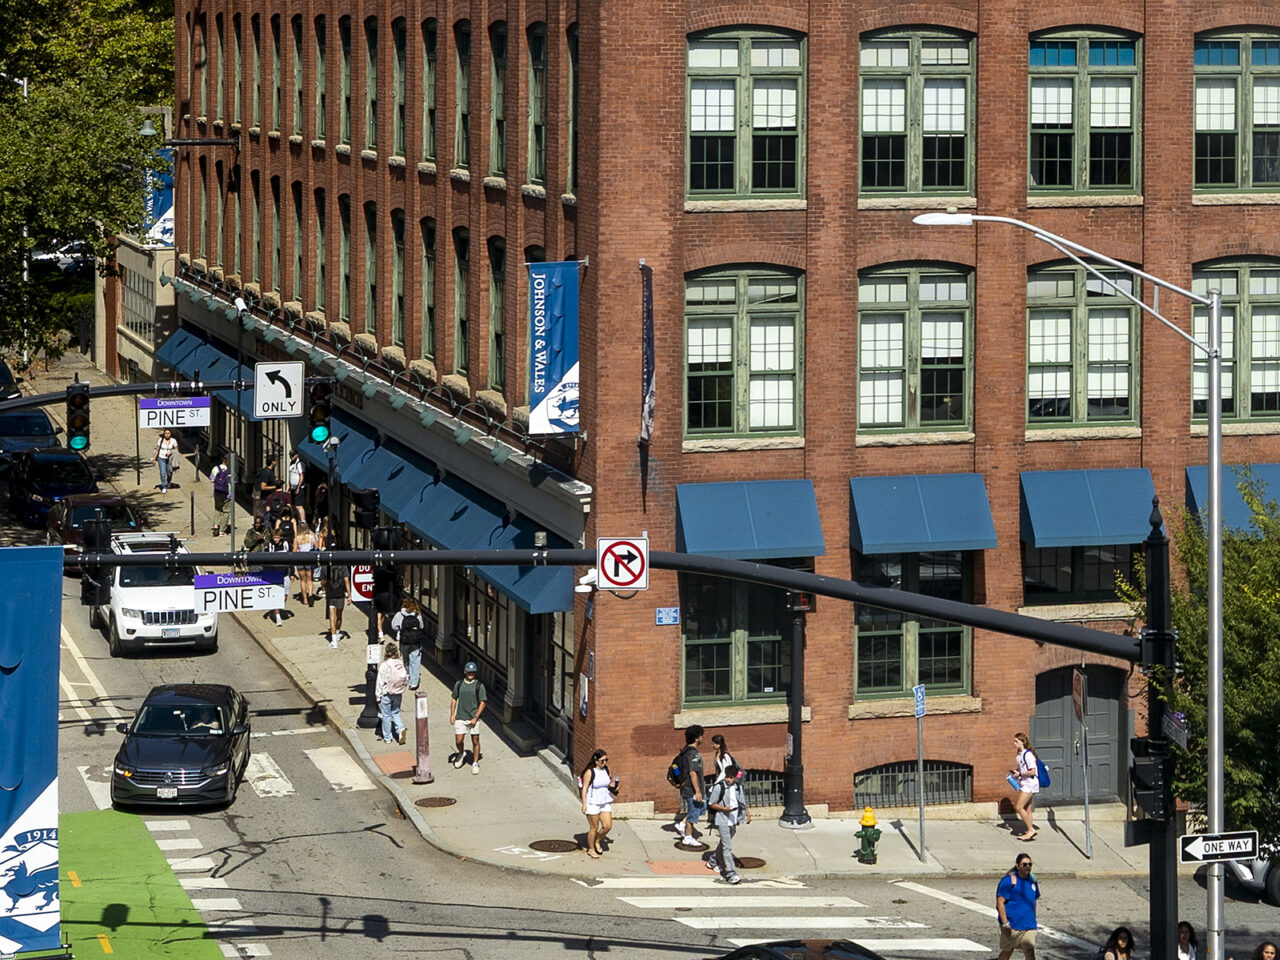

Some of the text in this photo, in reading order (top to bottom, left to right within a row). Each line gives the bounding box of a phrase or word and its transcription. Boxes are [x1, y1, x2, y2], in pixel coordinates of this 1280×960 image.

[532, 273, 547, 393] JOHNSON & WALES
[262, 401, 297, 412] ONLY
[147, 409, 186, 426] PINE
[203, 587, 275, 611] PINE ST.
[26, 829, 57, 842] 1914
[1204, 840, 1249, 853] ONE WAY
